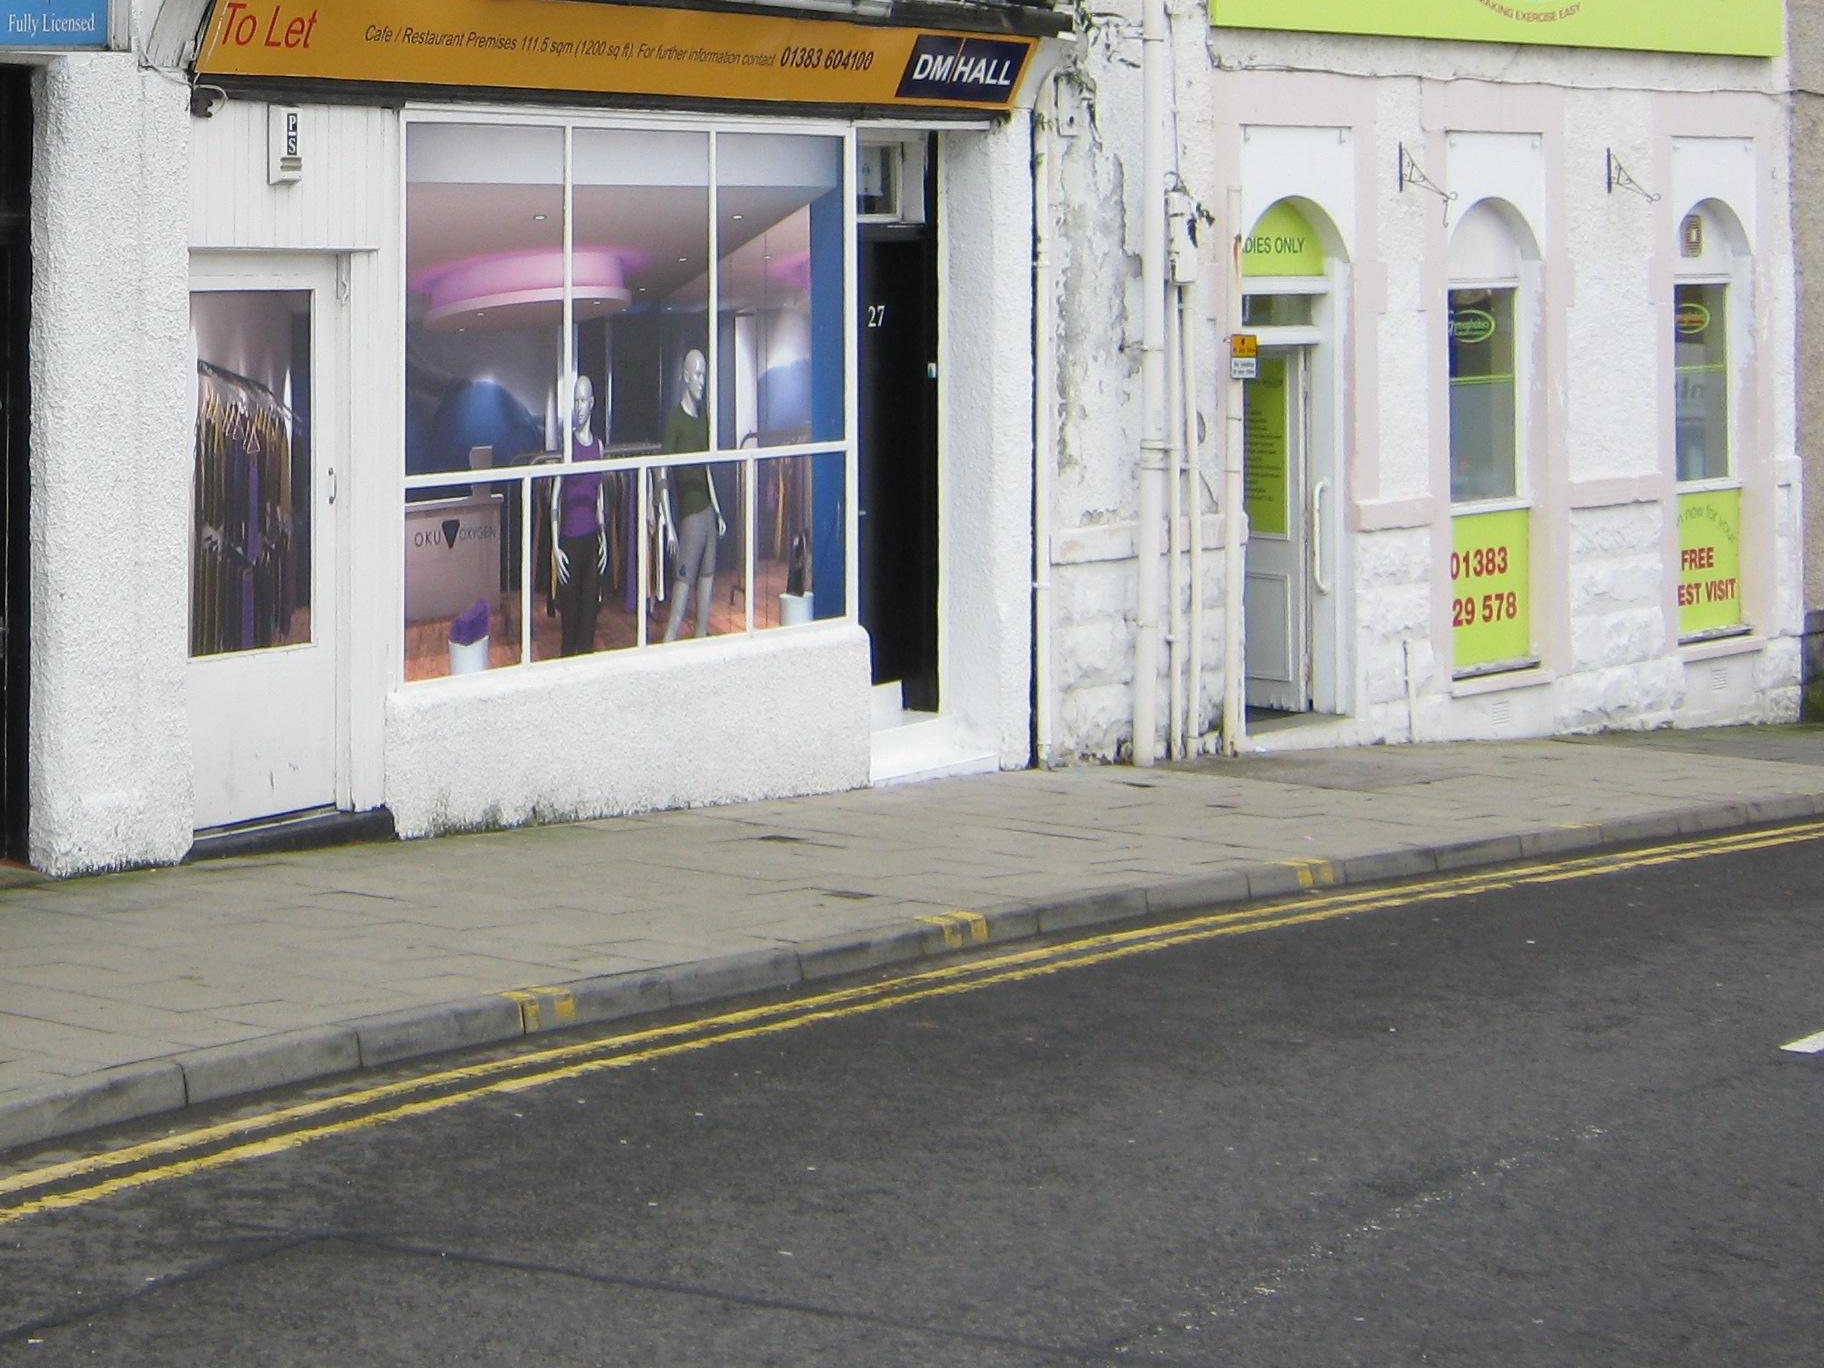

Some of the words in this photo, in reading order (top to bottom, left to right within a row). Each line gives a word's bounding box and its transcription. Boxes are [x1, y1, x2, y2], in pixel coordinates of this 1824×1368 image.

[1559, 2, 1581, 19] EASY
[8, 13, 39, 38] Fully
[42, 12, 95, 32] Licensed
[221, 2, 257, 47] To
[264, 5, 318, 50] Let
[364, 24, 392, 43] Cafe
[403, 27, 465, 47] Restaurant
[466, 31, 517, 51] Premises
[520, 35, 548, 54] 111.5
[550, 39, 573, 56] sqm
[574, 38, 606, 59] (1200
[607, 45, 619, 59] sq
[637, 43, 654, 59] For
[656, 45, 687, 62] further
[688, 48, 741, 66] information
[742, 50, 774, 67] contact
[780, 46, 823, 70] 01383
[824, 48, 875, 72] 604100
[912, 53, 952, 84] DM
[952, 55, 1012, 87] HALL
[287, 114, 298, 131] P
[287, 136, 298, 155] S
[1242, 237, 1272, 254] DIES
[1275, 237, 1305, 254] ONLY
[868, 305, 885, 327] 27
[1449, 545, 1509, 581] 01383
[1681, 546, 1715, 571] FREE
[1705, 578, 1736, 603] VISIT
[1482, 590, 1518, 624] 578
